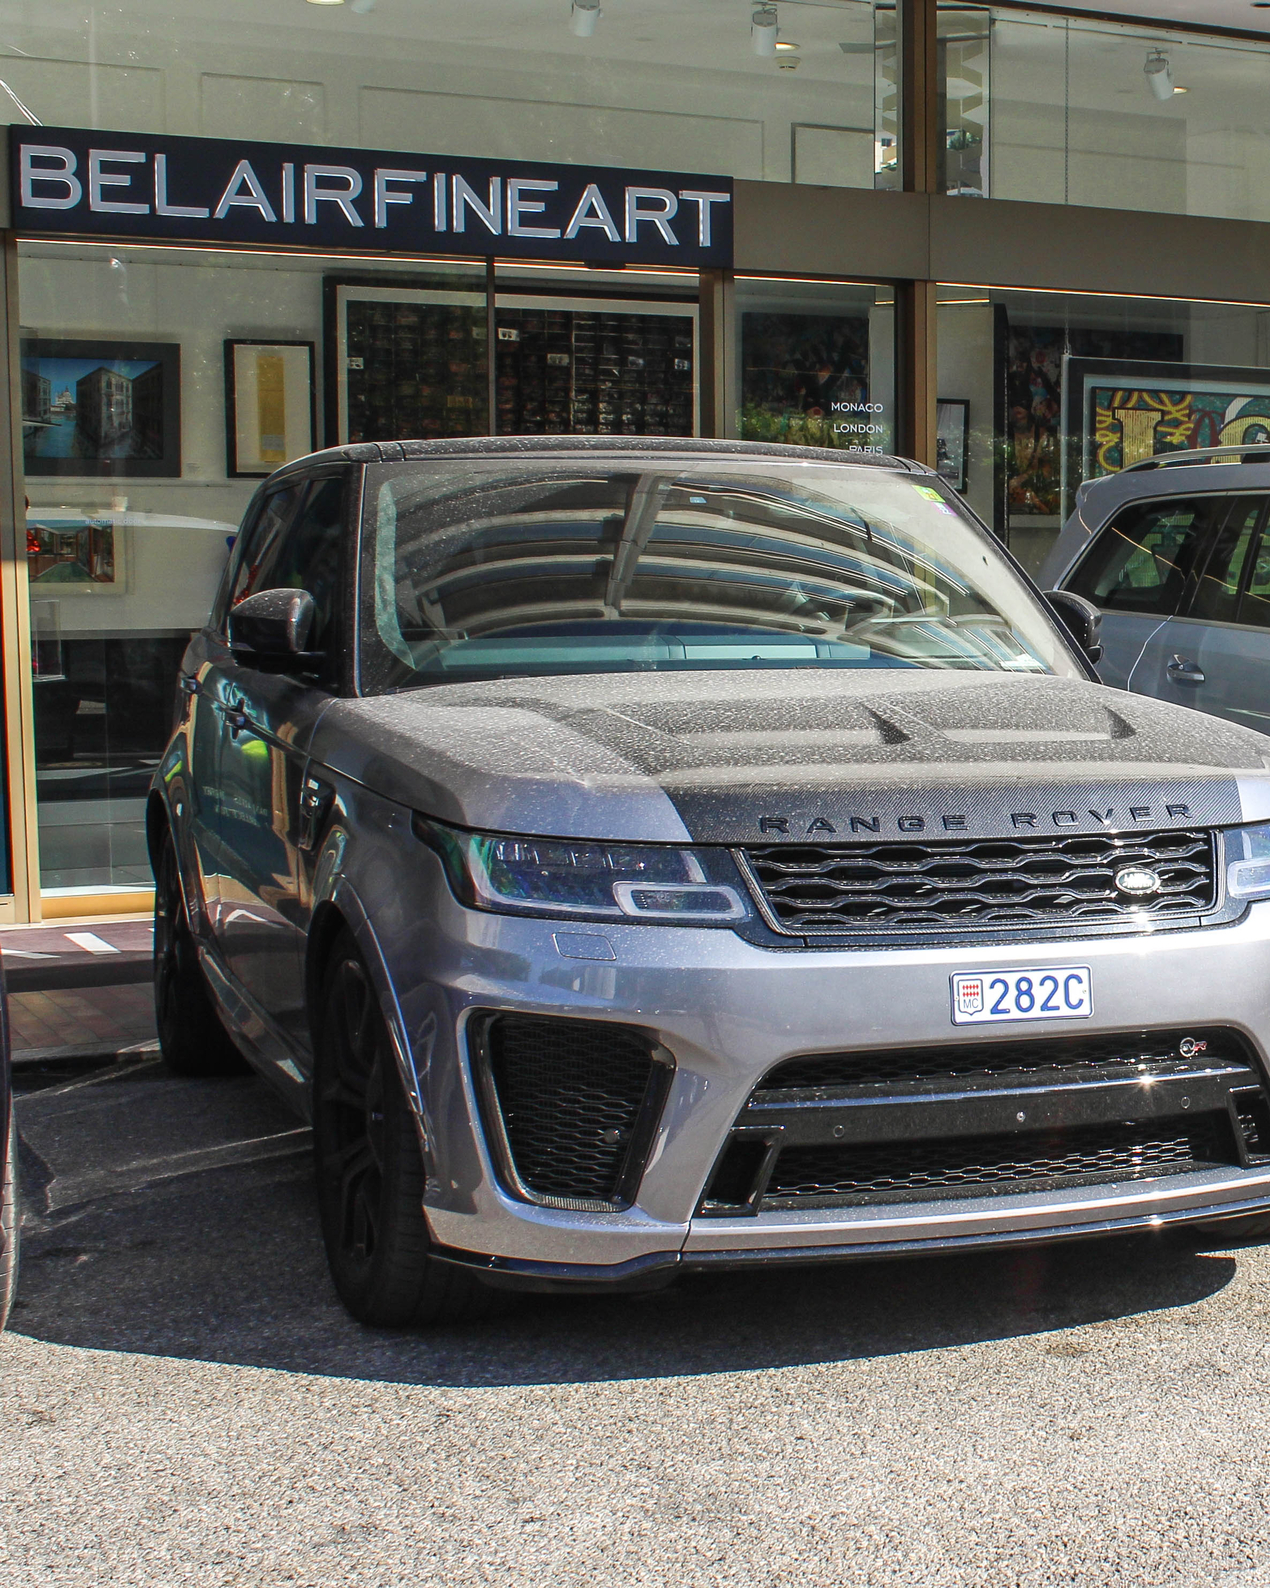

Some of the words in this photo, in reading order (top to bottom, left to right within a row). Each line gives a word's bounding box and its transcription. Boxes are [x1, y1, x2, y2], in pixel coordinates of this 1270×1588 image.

[831, 402, 883, 413] MONACO
[833, 423, 883, 434] LONDON
[758, 814, 970, 834] RANGE
[1011, 803, 1192, 829] ROVER
[989, 974, 1084, 1014] 282C
[963, 998, 979, 1009] MC
